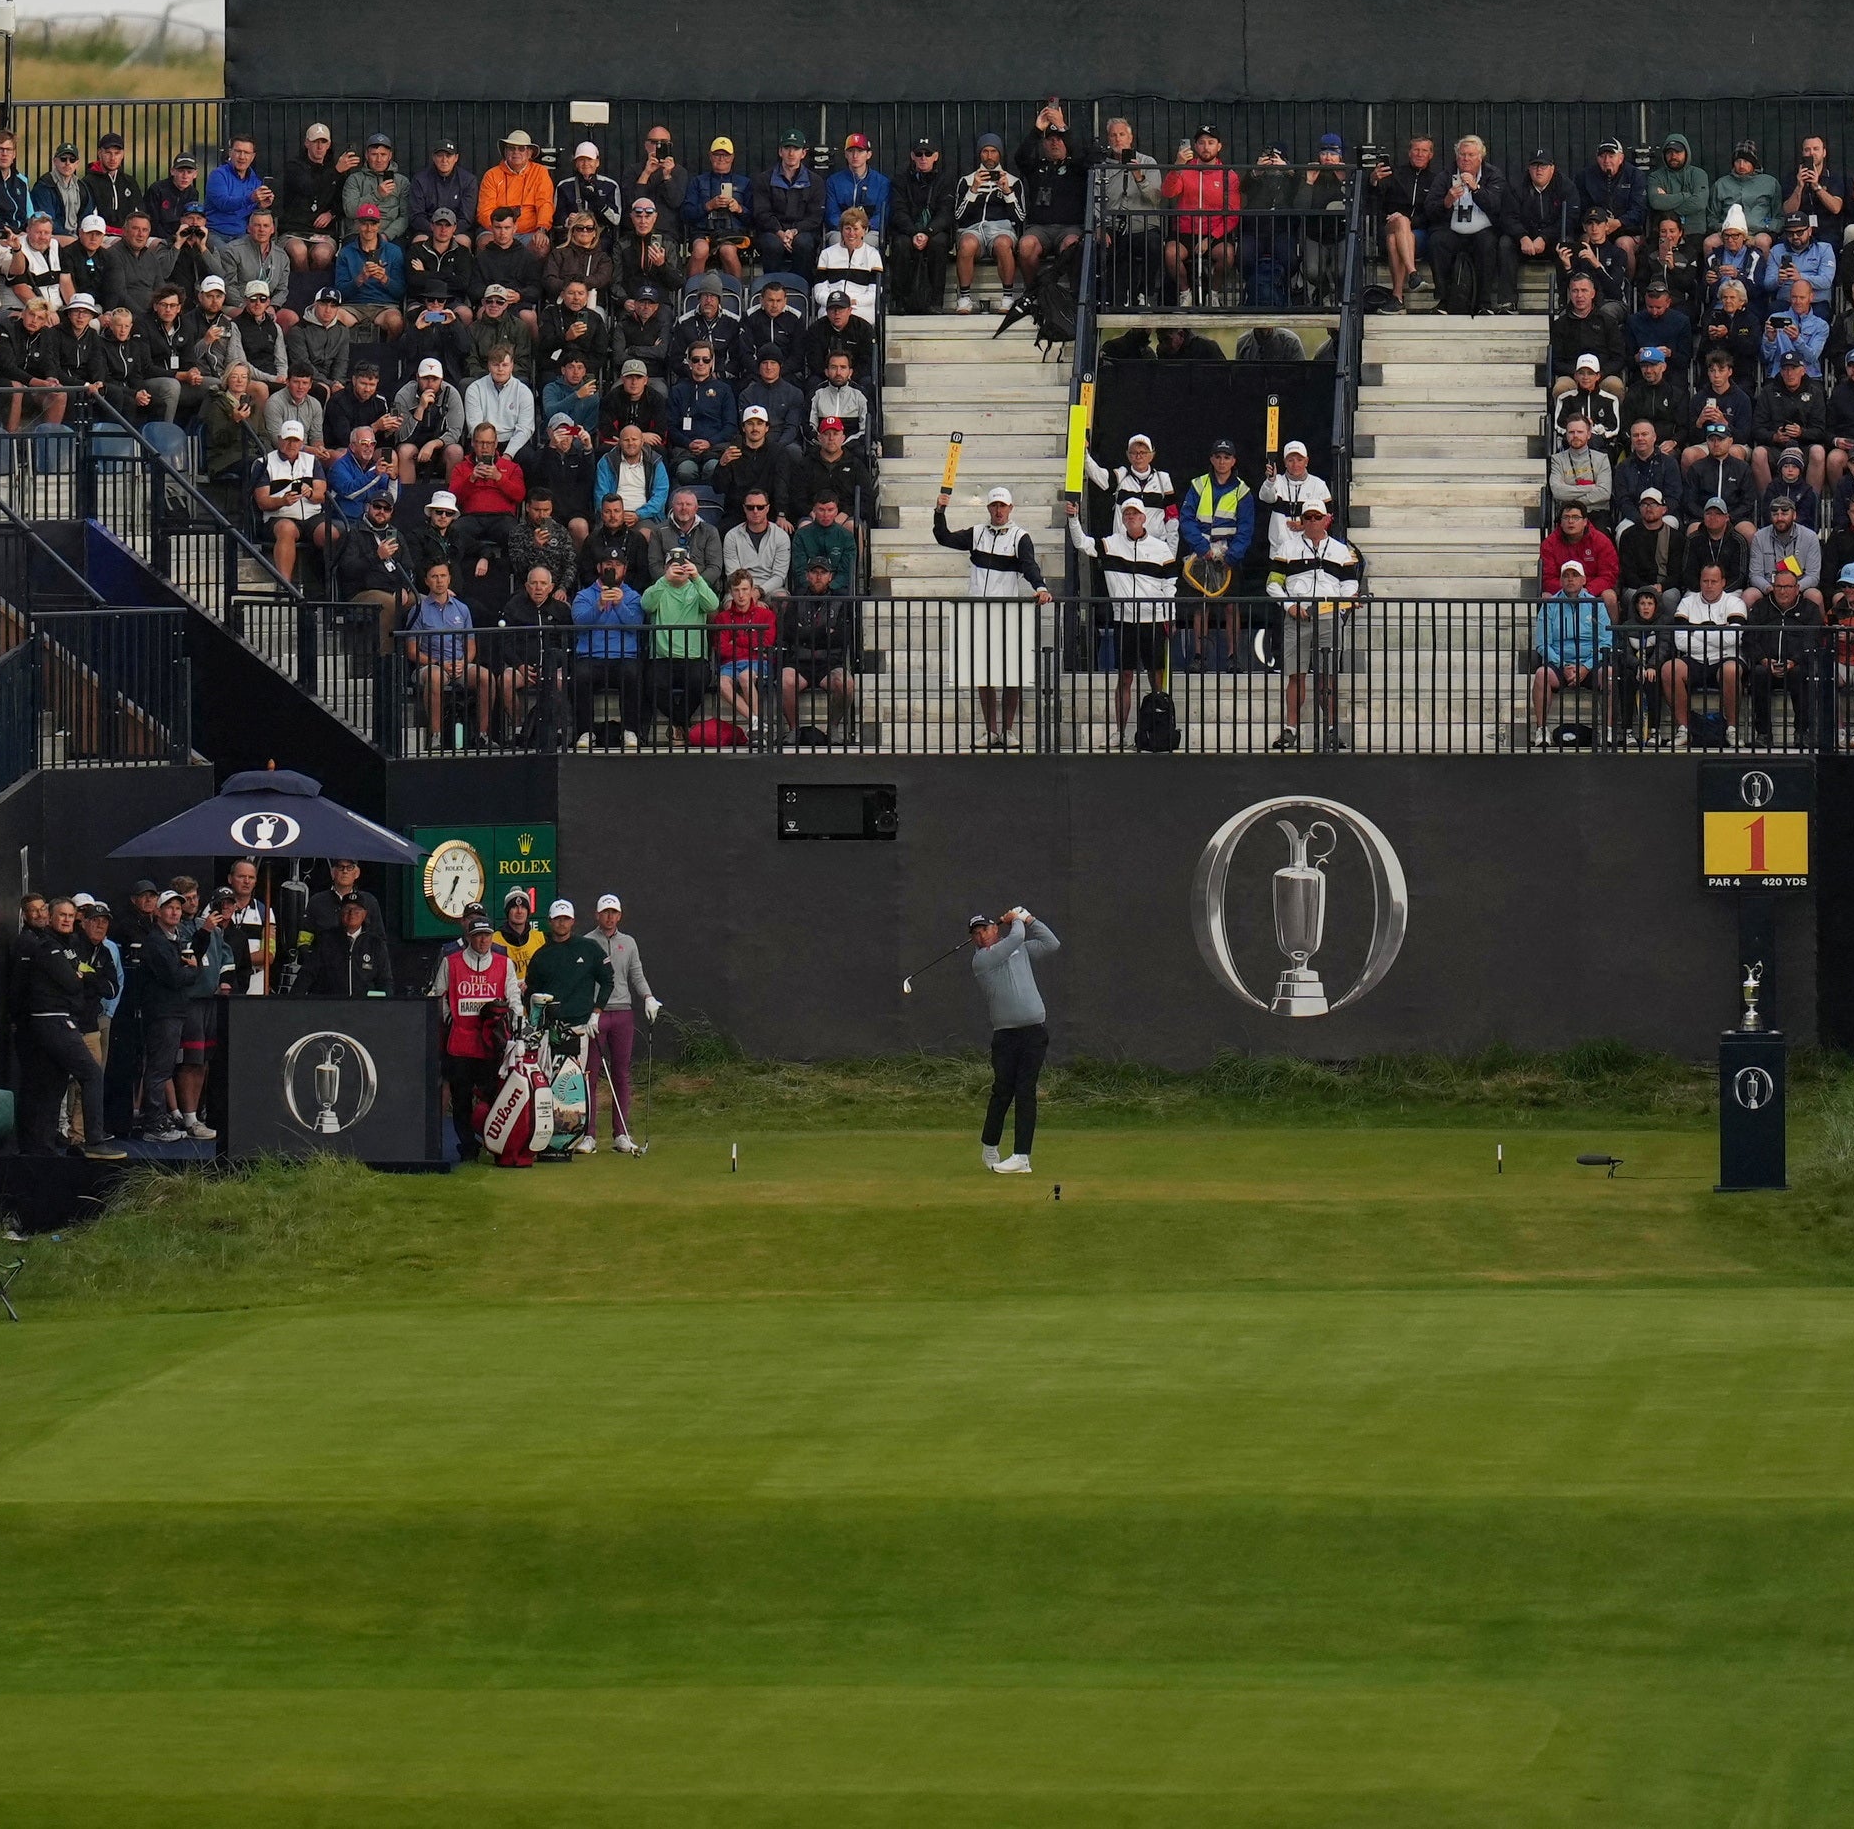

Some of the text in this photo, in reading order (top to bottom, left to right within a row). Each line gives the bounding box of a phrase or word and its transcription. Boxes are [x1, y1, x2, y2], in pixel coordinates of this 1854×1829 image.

[1743, 814, 1769, 872] 1
[498, 859, 552, 874] ROLEX
[1708, 877, 1741, 887] PAR 4
[1761, 877, 1808, 887] 420 YDS
[470, 975, 487, 984] THE
[458, 980, 497, 996] OPEN
[487, 1087, 523, 1140] Wilson
